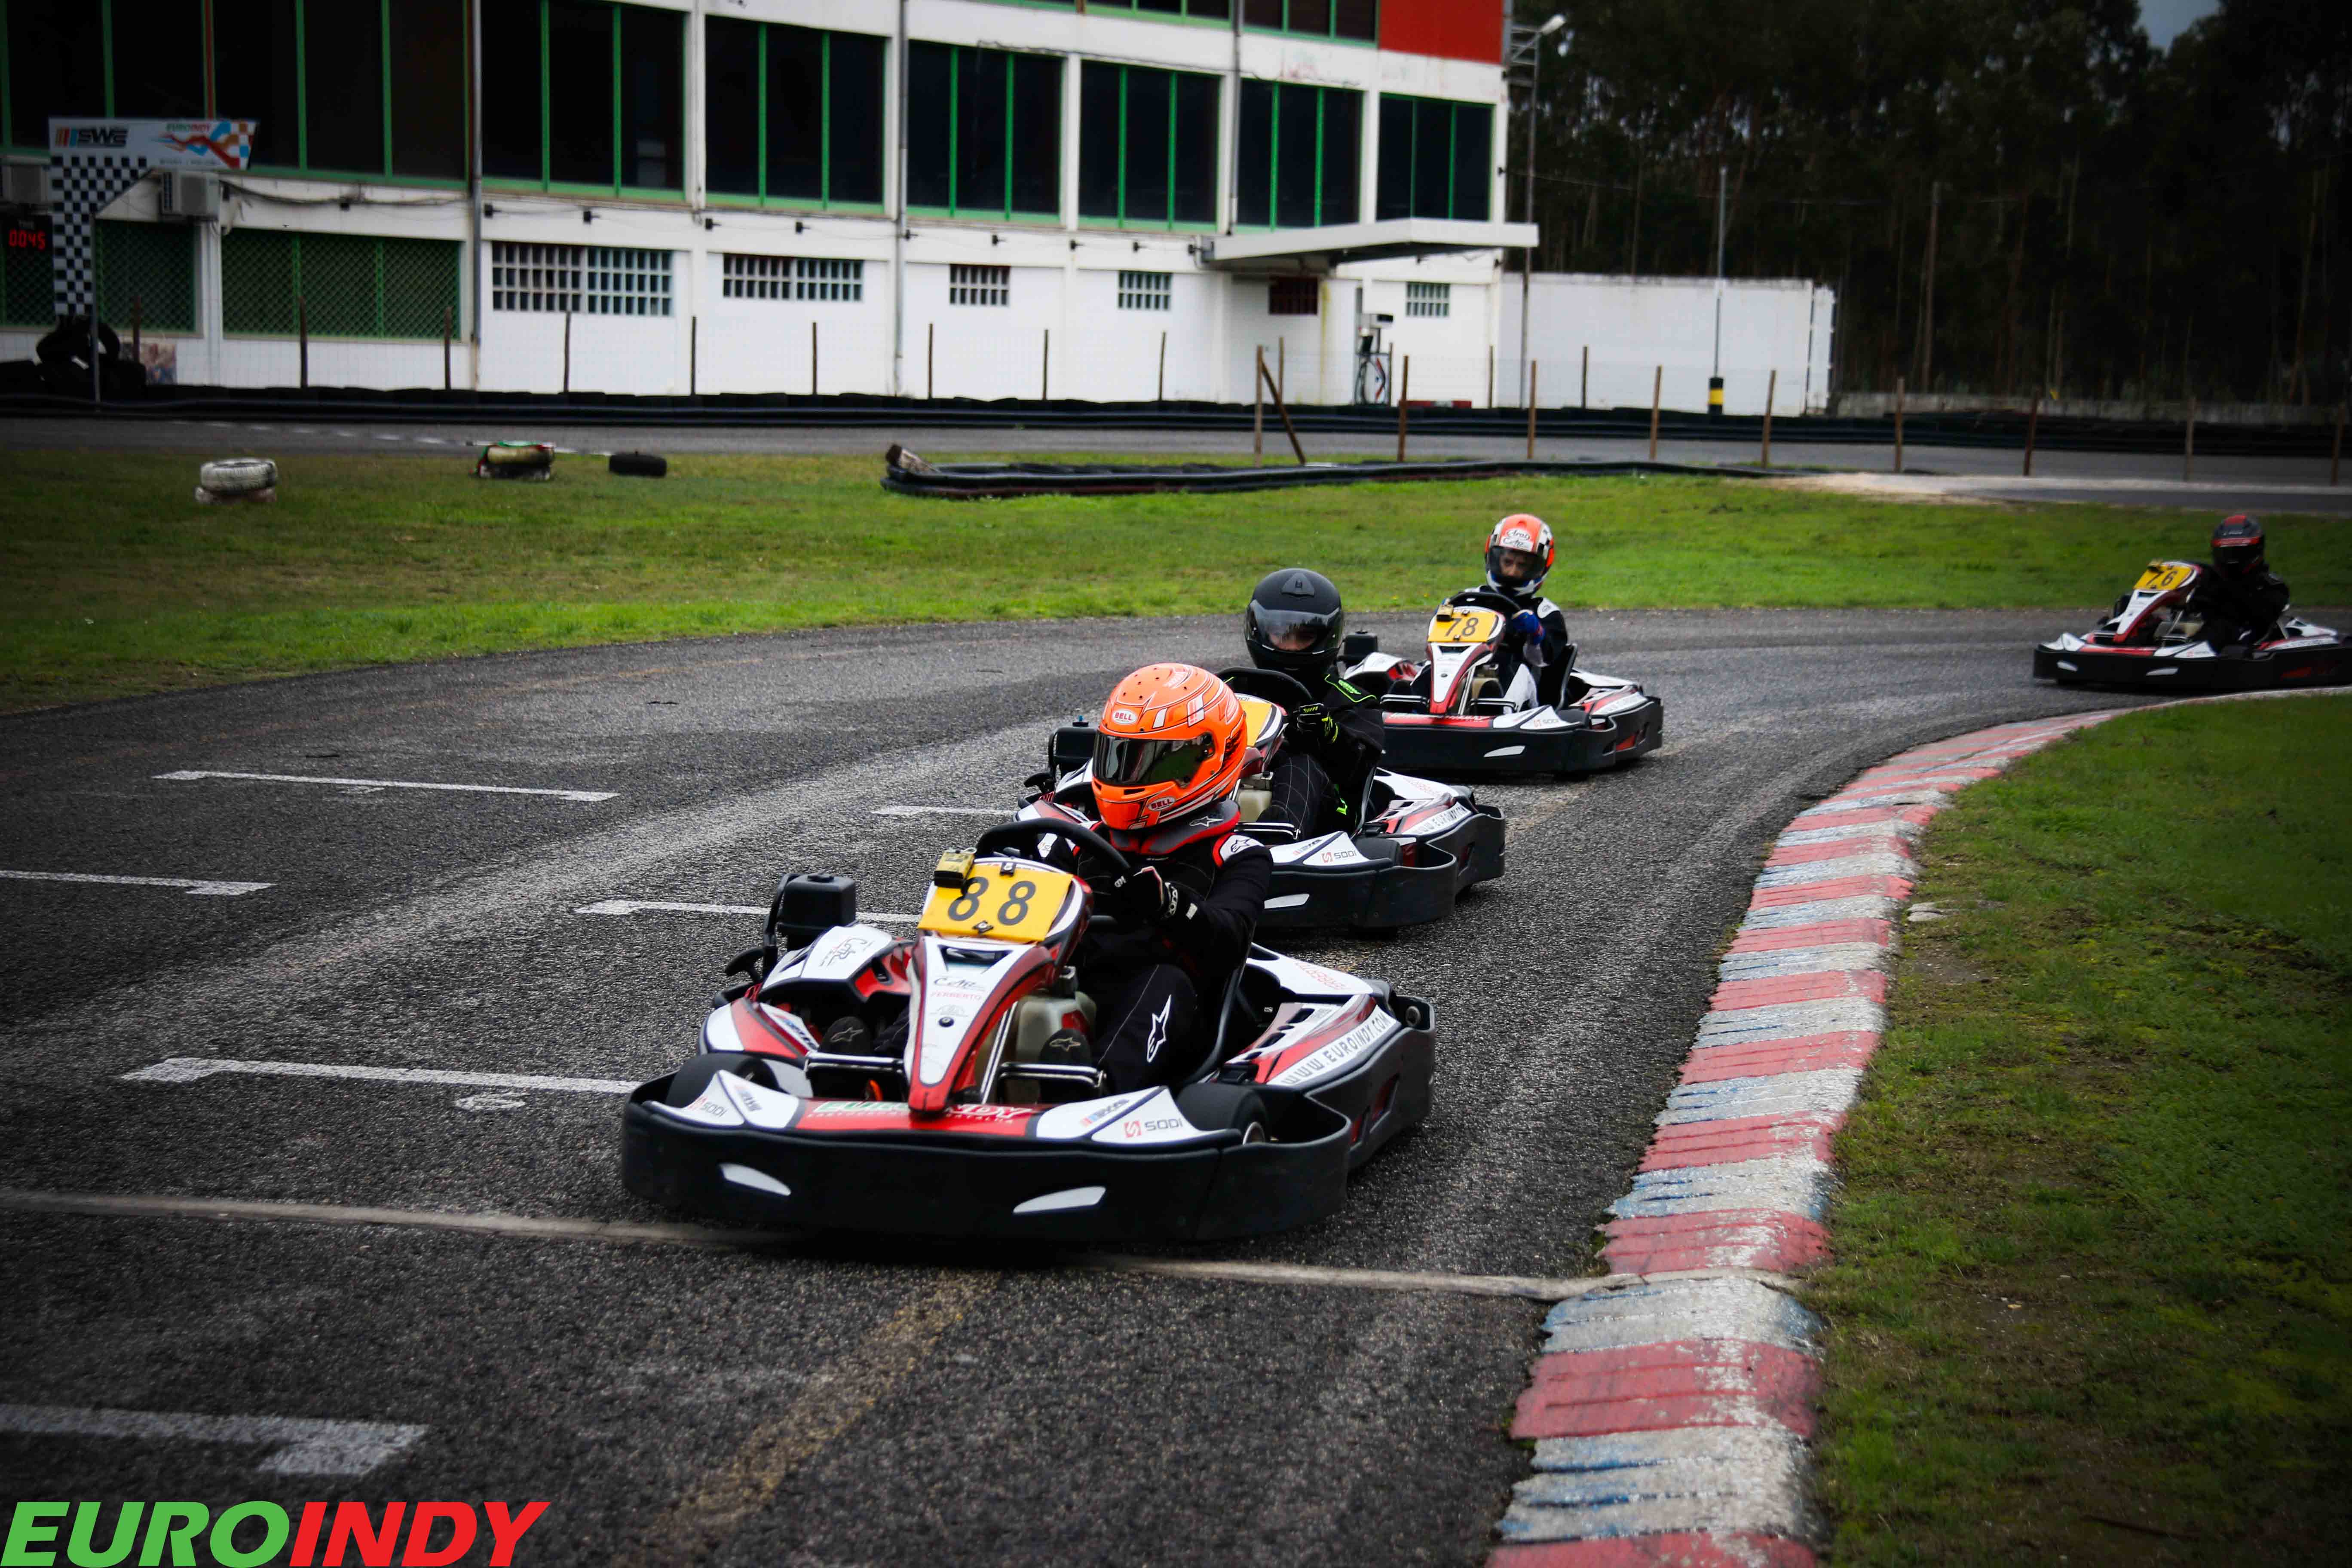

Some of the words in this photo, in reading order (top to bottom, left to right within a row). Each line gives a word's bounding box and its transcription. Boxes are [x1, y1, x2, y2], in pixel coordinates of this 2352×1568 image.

[2146, 570, 2178, 586] 76
[1445, 618, 1479, 636] 78
[1115, 712, 1132, 721] BELL
[1151, 799, 1173, 808] BELL
[1334, 851, 1357, 859] SODI
[948, 876, 1036, 926] 88
[701, 1102, 727, 1118] SODI
[1145, 1118, 1183, 1131] SODI
